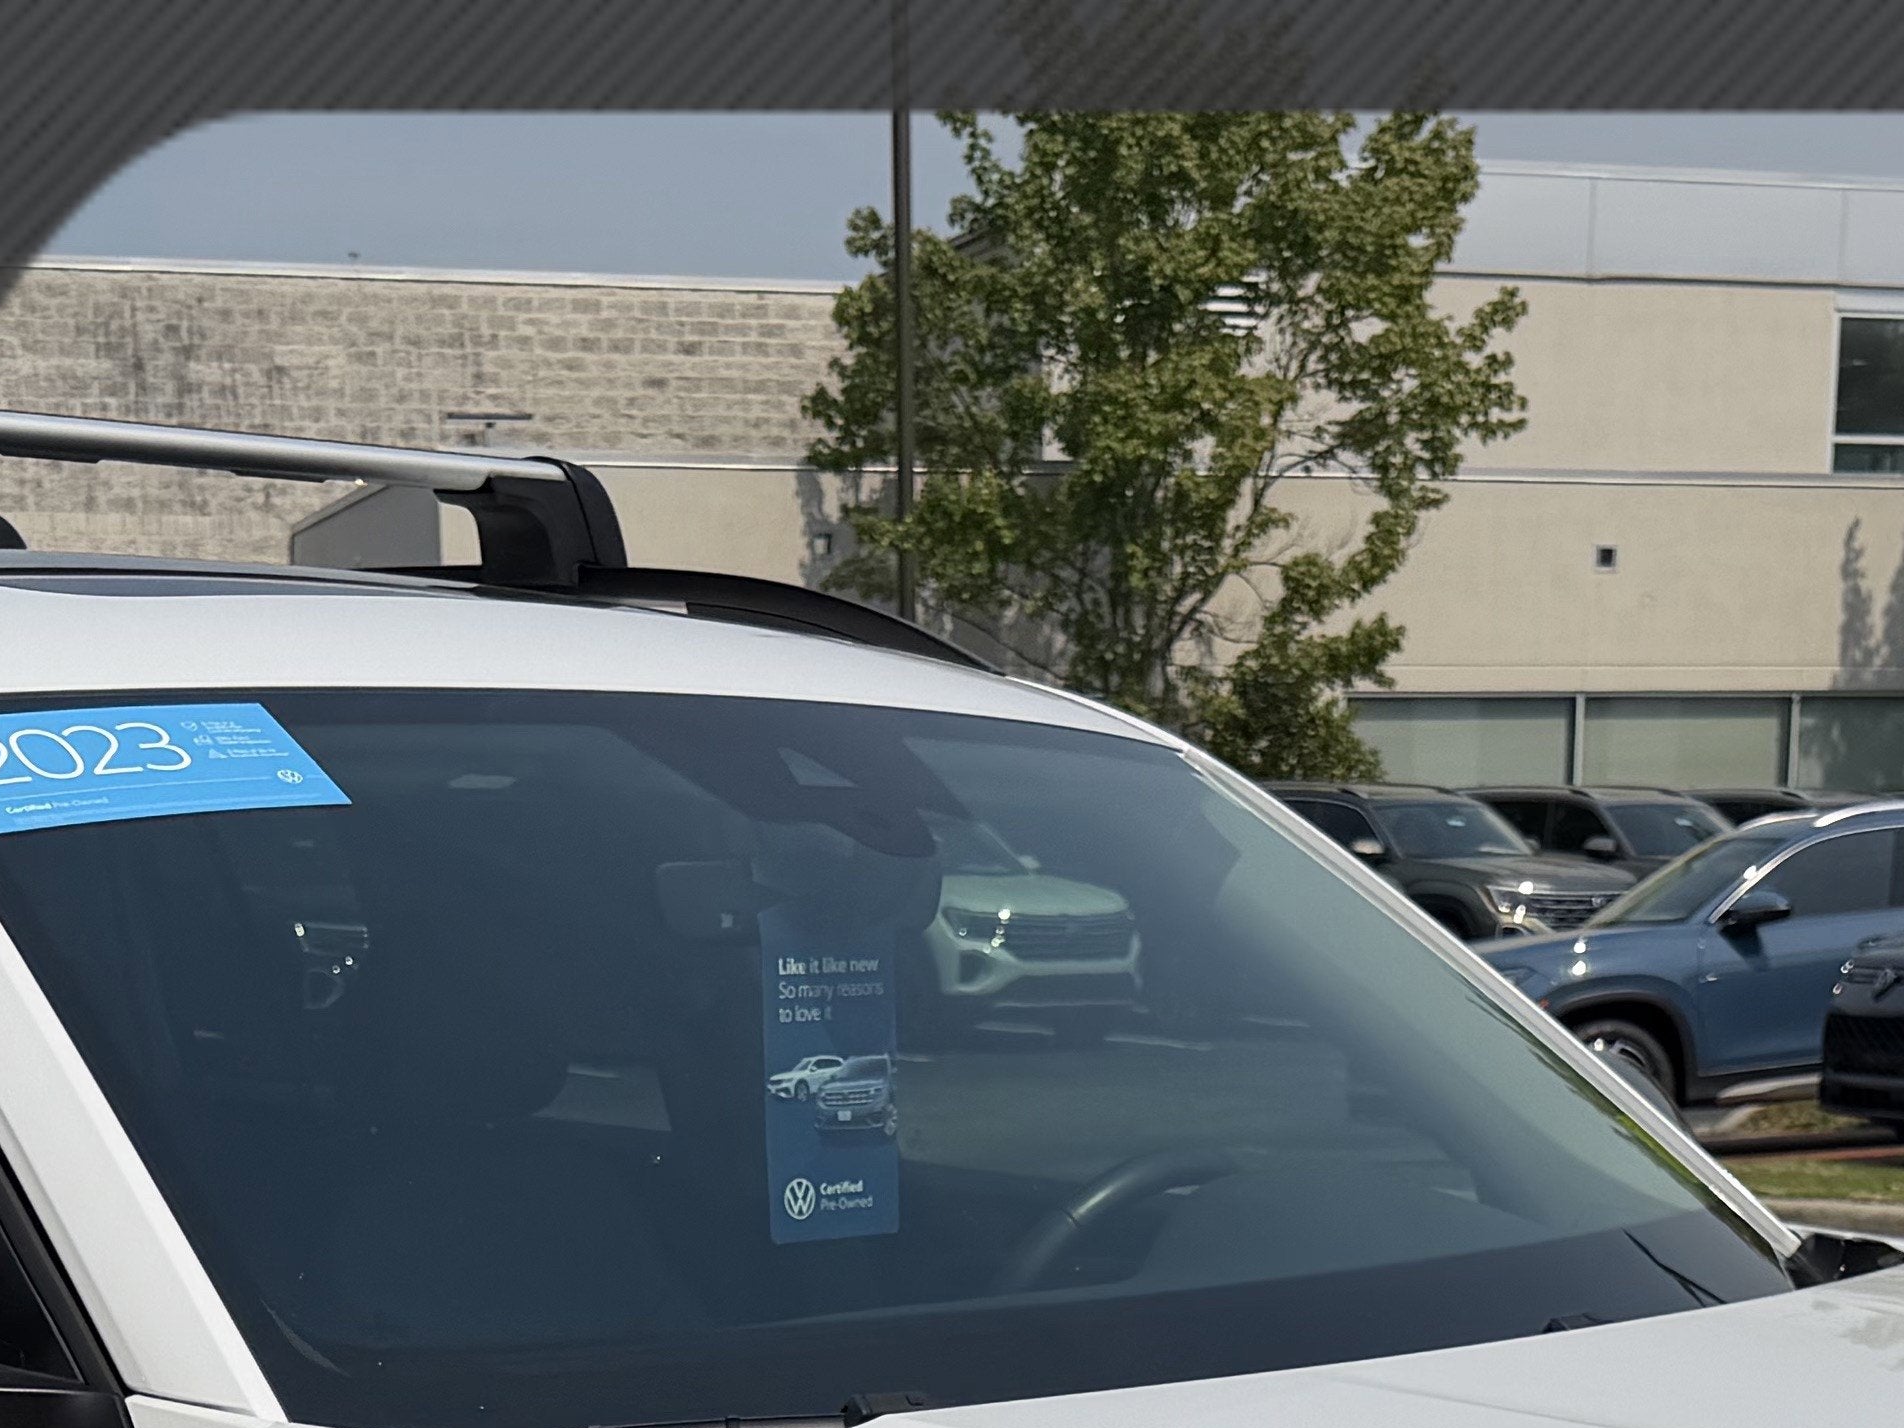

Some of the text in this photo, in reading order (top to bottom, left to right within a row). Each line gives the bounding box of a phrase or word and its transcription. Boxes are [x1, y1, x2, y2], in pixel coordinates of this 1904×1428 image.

[778, 958, 806, 975] Like
[849, 959, 879, 972] new
[778, 981, 796, 999] So
[798, 984, 833, 1001] many
[779, 1008, 793, 1023] to
[794, 1005, 822, 1022] love
[819, 1180, 864, 1195] Certified
